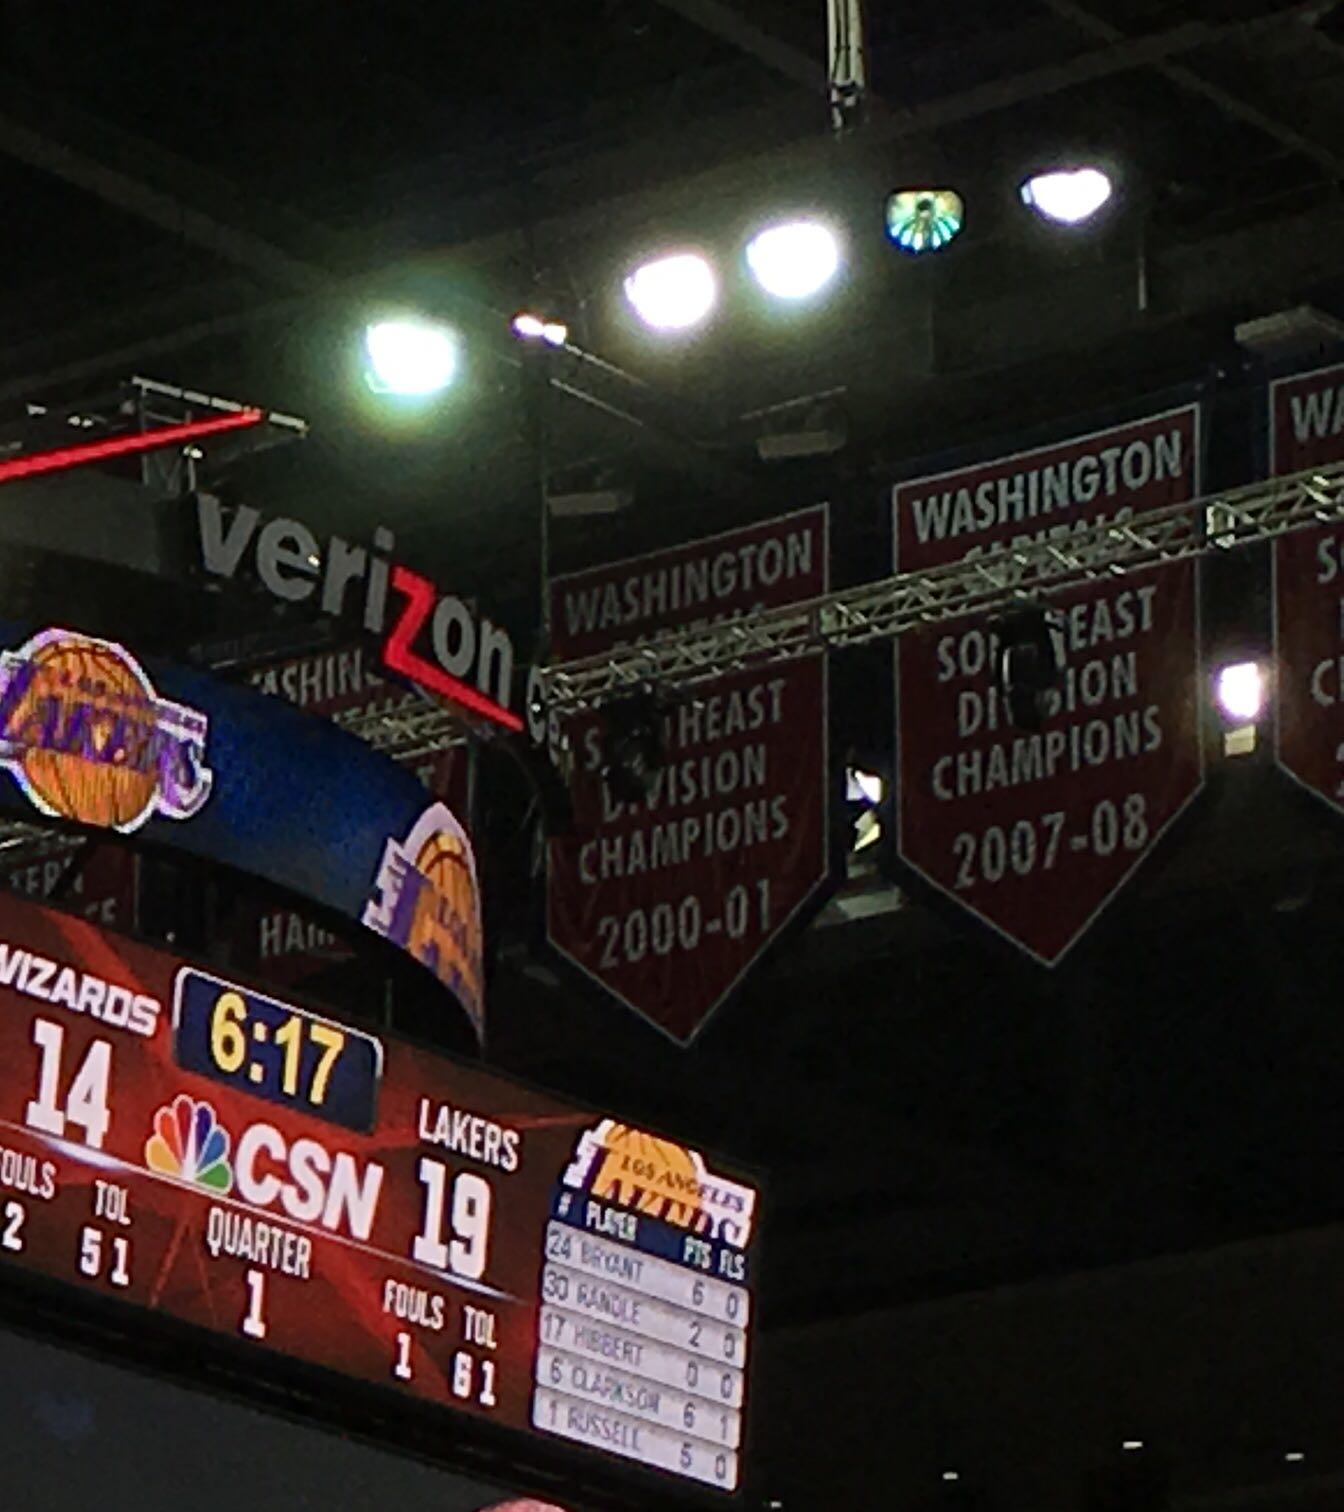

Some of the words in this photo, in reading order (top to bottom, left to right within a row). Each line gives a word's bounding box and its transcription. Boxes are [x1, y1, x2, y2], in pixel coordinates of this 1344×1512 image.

[912, 429, 1183, 544] WASHINGTON
[196, 494, 522, 728] verizon
[564, 529, 812, 637] WASHINGTON
[932, 704, 1162, 801] CHAMPIONS
[579, 795, 789, 885] CHAMPIONS
[952, 792, 1149, 889] 2007-08
[598, 880, 773, 971] 2000-01
[27, 1018, 111, 1150] 14
[211, 992, 344, 1105] 6:17
[236, 1123, 383, 1240] CSN
[419, 1099, 520, 1171] LAKERS
[2, 1202, 23, 1252] 2
[94, 1180, 132, 1226] TOL
[208, 1206, 311, 1279] QUARTER
[413, 1159, 493, 1281] 19
[243, 1271, 266, 1339] 1
[383, 1279, 445, 1331] FOULS
[464, 1306, 496, 1349] TOL
[395, 1331, 411, 1379] 1
